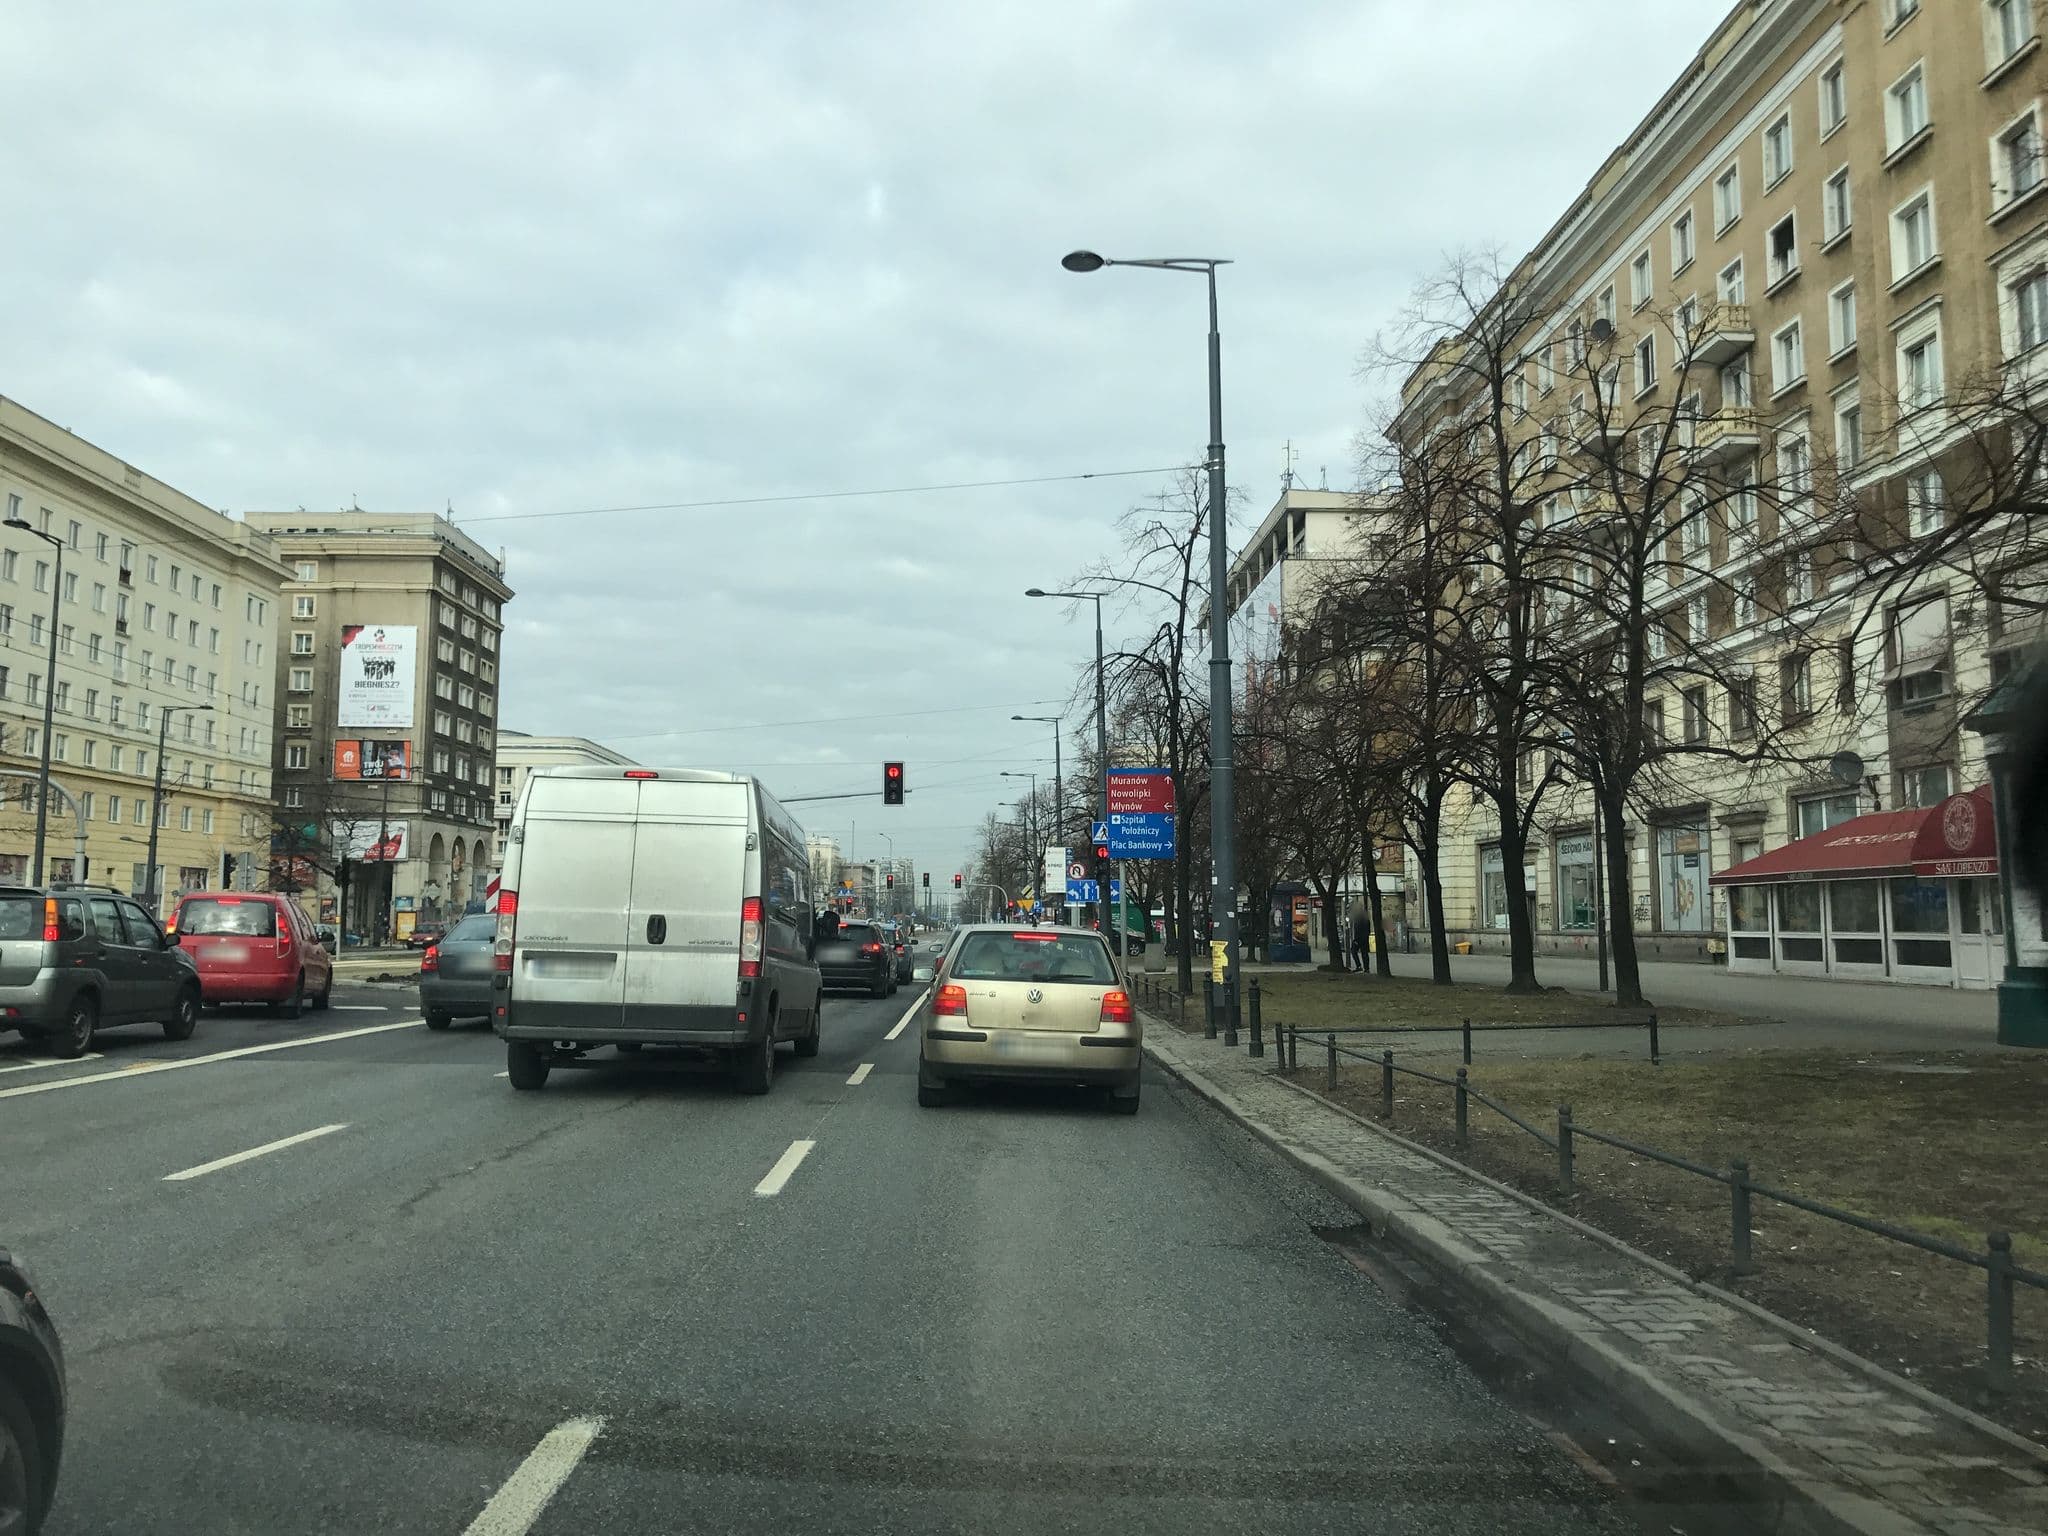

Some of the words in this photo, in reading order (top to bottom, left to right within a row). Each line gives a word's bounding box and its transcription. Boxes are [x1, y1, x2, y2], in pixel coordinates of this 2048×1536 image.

[1111, 775, 1148, 785] Muranów
[1111, 788, 1151, 800] Nowolipki
[1121, 814, 1146, 826] Szpital
[1111, 840, 1127, 849] Plac
[1128, 840, 1163, 851] Bankowy
[1935, 863, 1951, 874] SAN
[1953, 861, 1989, 874] LORENZO
